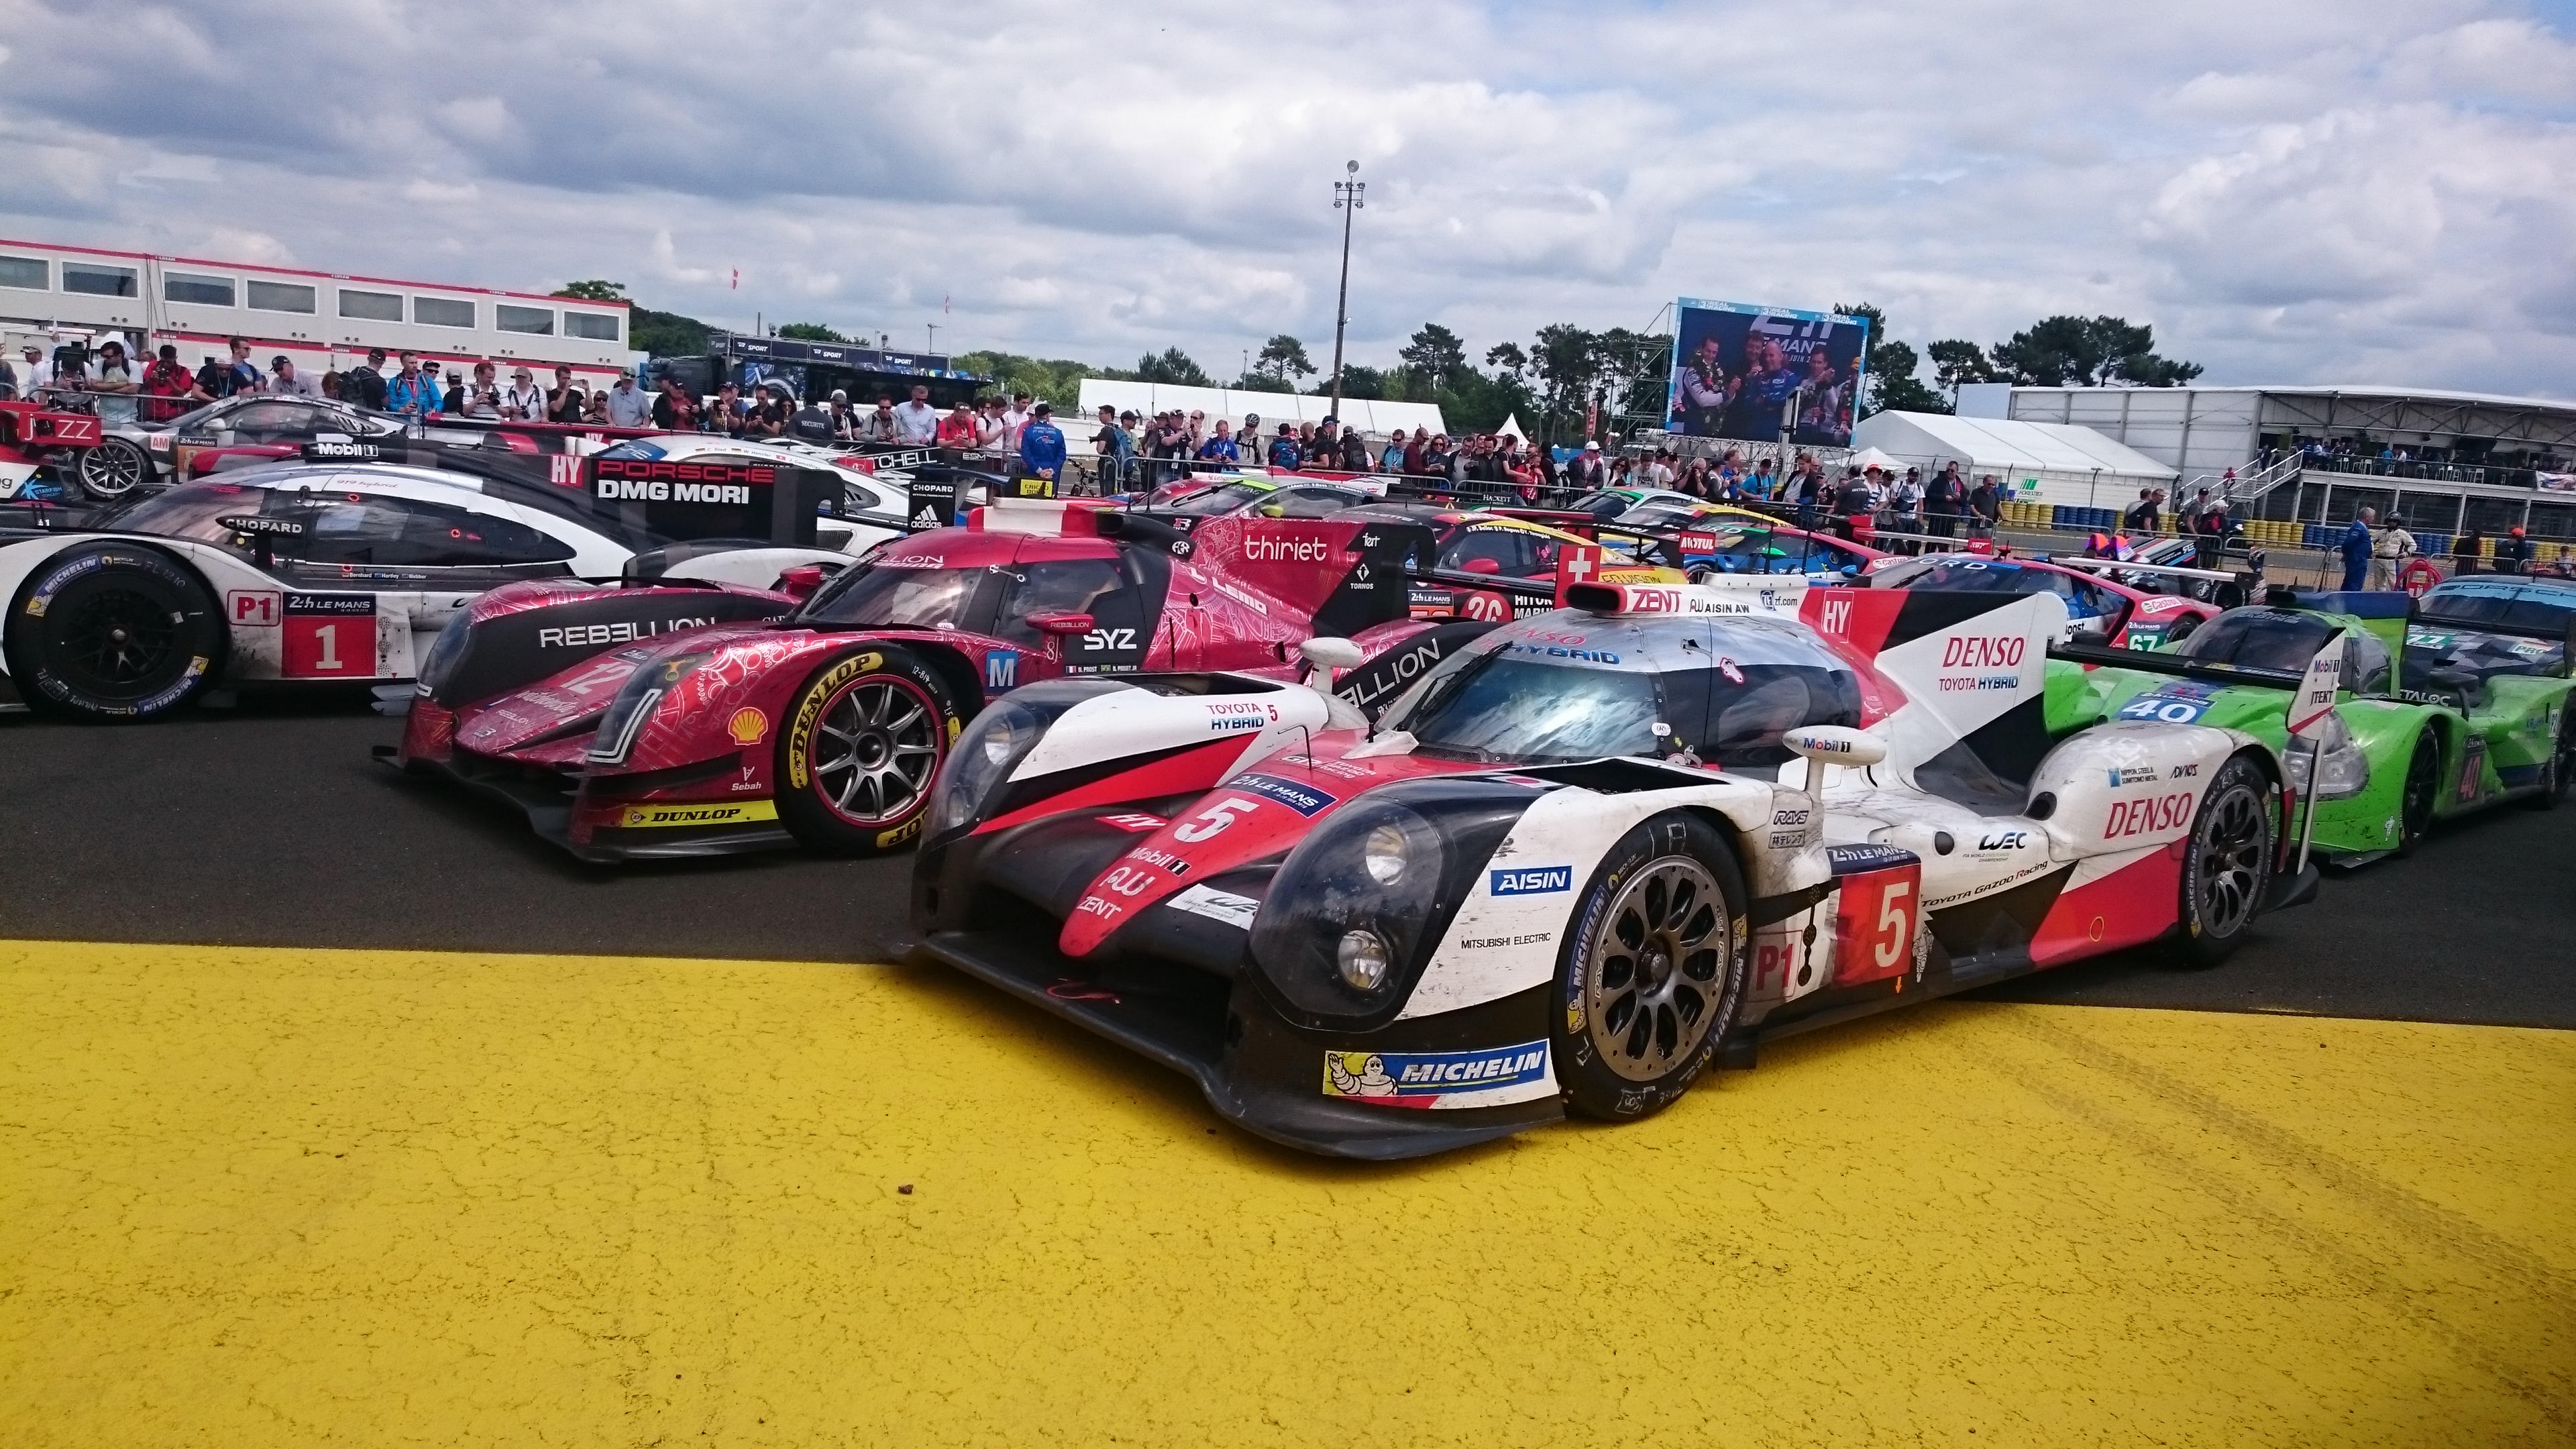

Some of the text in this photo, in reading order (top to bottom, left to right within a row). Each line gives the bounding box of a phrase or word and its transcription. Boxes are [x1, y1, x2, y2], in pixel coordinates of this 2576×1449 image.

[747, 344, 768, 352] SPORT
[894, 358, 912, 366] SPORT
[801, 419, 824, 429] SECURITE
[152, 437, 168, 450] AM
[319, 443, 363, 456] Mobil
[963, 453, 985, 461] ESM
[551, 455, 582, 484] HY
[598, 460, 775, 483] PORSCHE
[598, 480, 749, 504] DMG MORI
[912, 484, 953, 492] CHOPARD
[225, 519, 302, 534] CHOPARD
[911, 519, 942, 529] adidas
[1244, 535, 1327, 561] thiriet
[1680, 537, 1714, 550] MOTUL
[876, 554, 943, 564] LLION
[46, 559, 96, 593] MICHELIN
[2438, 584, 2576, 598] PORSCH
[237, 596, 272, 621] P1
[317, 601, 333, 609] LE
[334, 601, 370, 609] MANS
[1632, 590, 1750, 613] ZENT AISIN AW
[1775, 596, 1798, 606] zf.com
[2151, 598, 2180, 610] Castrol
[1823, 600, 1851, 635] HY
[2065, 621, 2085, 635] oost
[316, 625, 342, 669] 1
[1083, 629, 1137, 650] SYZ
[2129, 635, 2158, 652] 67
[1943, 637, 2025, 668] DENSO
[989, 659, 1014, 687] M
[2315, 659, 2332, 672] Mobil
[1939, 676, 2019, 692] TOYOTA HYBRID
[144, 678, 192, 712] MICHELIN
[2177, 696, 2208, 706] MANS
[2310, 691, 2333, 706] JTEKT
[792, 654, 870, 755] DUNLOP
[1205, 704, 1279, 722] TOYOTA 5
[2123, 700, 2196, 723] 40
[1211, 716, 1264, 730] HYBRID
[1803, 737, 1838, 752] Mobil
[731, 782, 761, 792] Sebah
[1255, 782, 1277, 790] LE
[1273, 787, 1319, 807] MANS
[651, 808, 741, 822] DUNLOP
[1106, 814, 1167, 827] HY
[1173, 798, 1260, 843] 5
[1774, 810, 1809, 824] RAYS
[2104, 792, 2192, 840] DENSO
[1979, 833, 2027, 851] WEC
[1126, 847, 1175, 867] Mobil
[1857, 845, 1906, 859] LE MANS
[1498, 871, 1566, 892] AISIN
[1922, 860, 2048, 908] TOYOTA GAZOO Racing
[1077, 896, 1122, 919] ZENT
[1874, 881, 1910, 968] 5
[1461, 932, 1551, 949] MITSUBISHI ELECTRIC
[1572, 892, 1606, 987] MICHELIN
[1756, 943, 1793, 991] P1
[1400, 1050, 1544, 1082] MICHELIN
